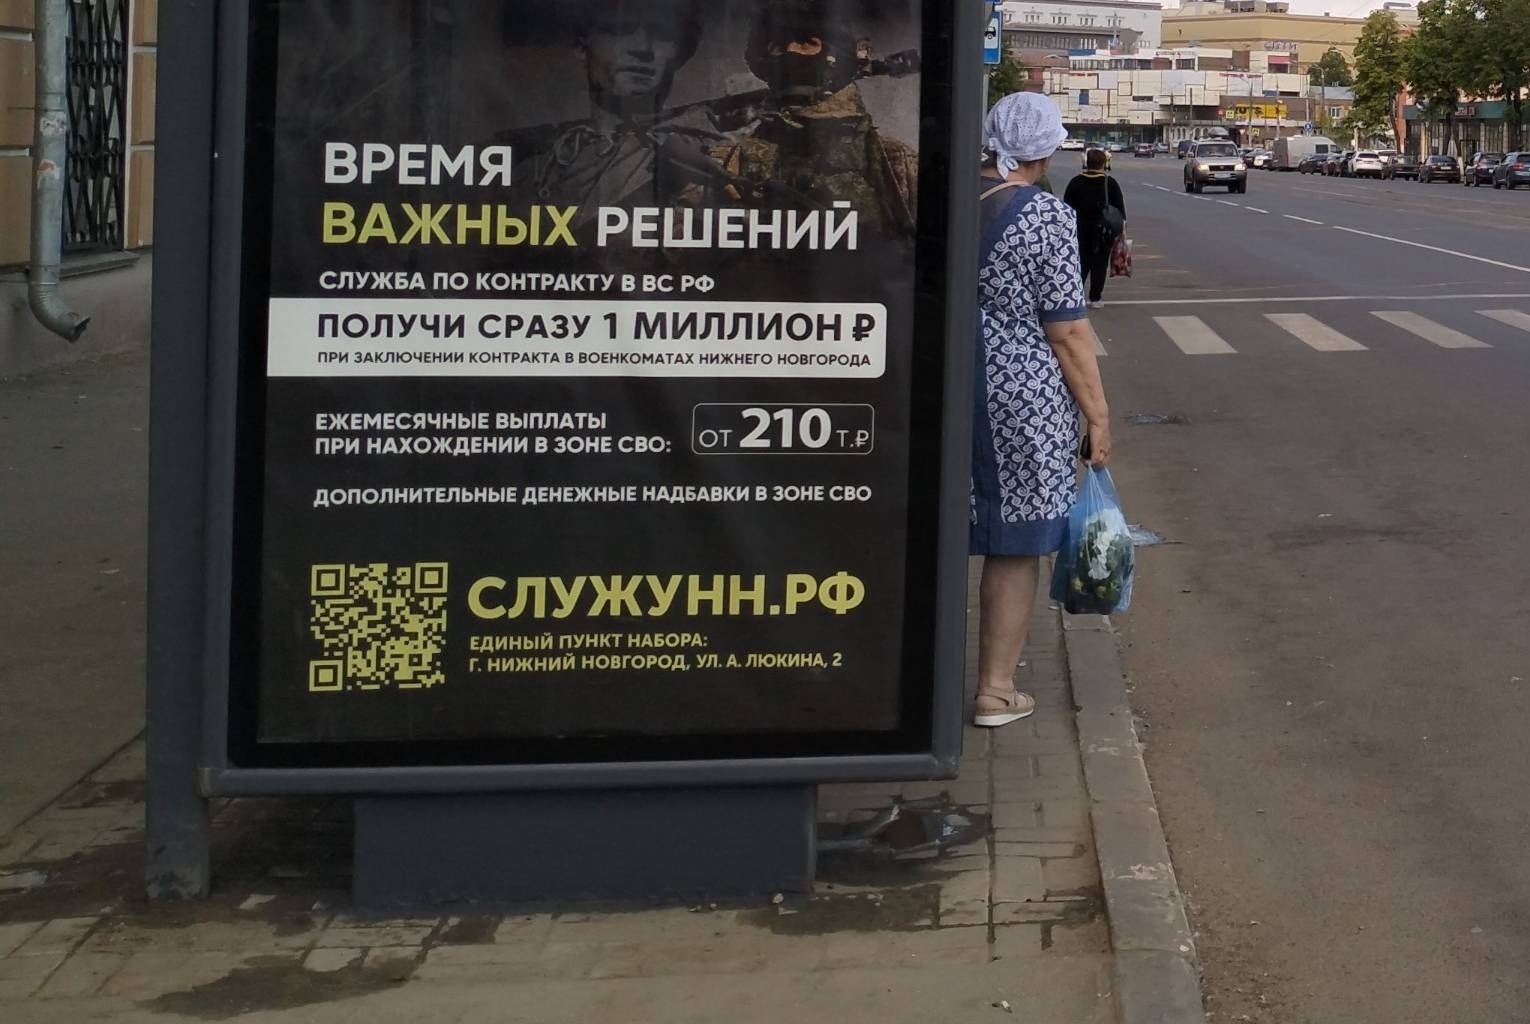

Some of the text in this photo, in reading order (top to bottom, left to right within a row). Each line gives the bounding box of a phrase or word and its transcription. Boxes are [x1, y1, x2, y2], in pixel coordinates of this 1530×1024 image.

[324, 142, 512, 187] ВРЕМЯ
[322, 200, 858, 250] ВАЖНЫХ РЕШЕНИЙ
[319, 270, 715, 293] СЛУЖБА ПО КОНТРАКТУ В ВС РФ
[317, 311, 876, 342] ПОЛУЧИ СРАЗУ 1 МИЛЛИОН ₽
[317, 351, 871, 368] ПРИ ЗАКЛЮЧЕНИИ КОНТРАКТА В ВОЕНКОМАТАХ НИЖНЕГО НОВГОРОДА
[315, 412, 607, 431] ЕЖЕМЕСЯЧНЫЕ ВЫПЛАТЫ
[698, 429, 733, 448] ОТ
[739, 407, 832, 449] 210
[315, 435, 671, 457] ПРИ НАХОЖДЕНИИ В ЗОНЕ СВО:
[313, 485, 872, 508] ДОПОЛНИТЕЛЬНЫЕ ДЕНЕЖНЫЕ НАДБАВКИ В ЗОНЕ СВО
[467, 571, 865, 619] СЛУЖУНН.РФ
[470, 632, 708, 653] ЕДИНЫЙ ПУНКТ НАБОРА:
[469, 652, 842, 673] Г. НИЖНИЙ НОВГОРОД, УЛ. А. ЛЮКИНА, 2
